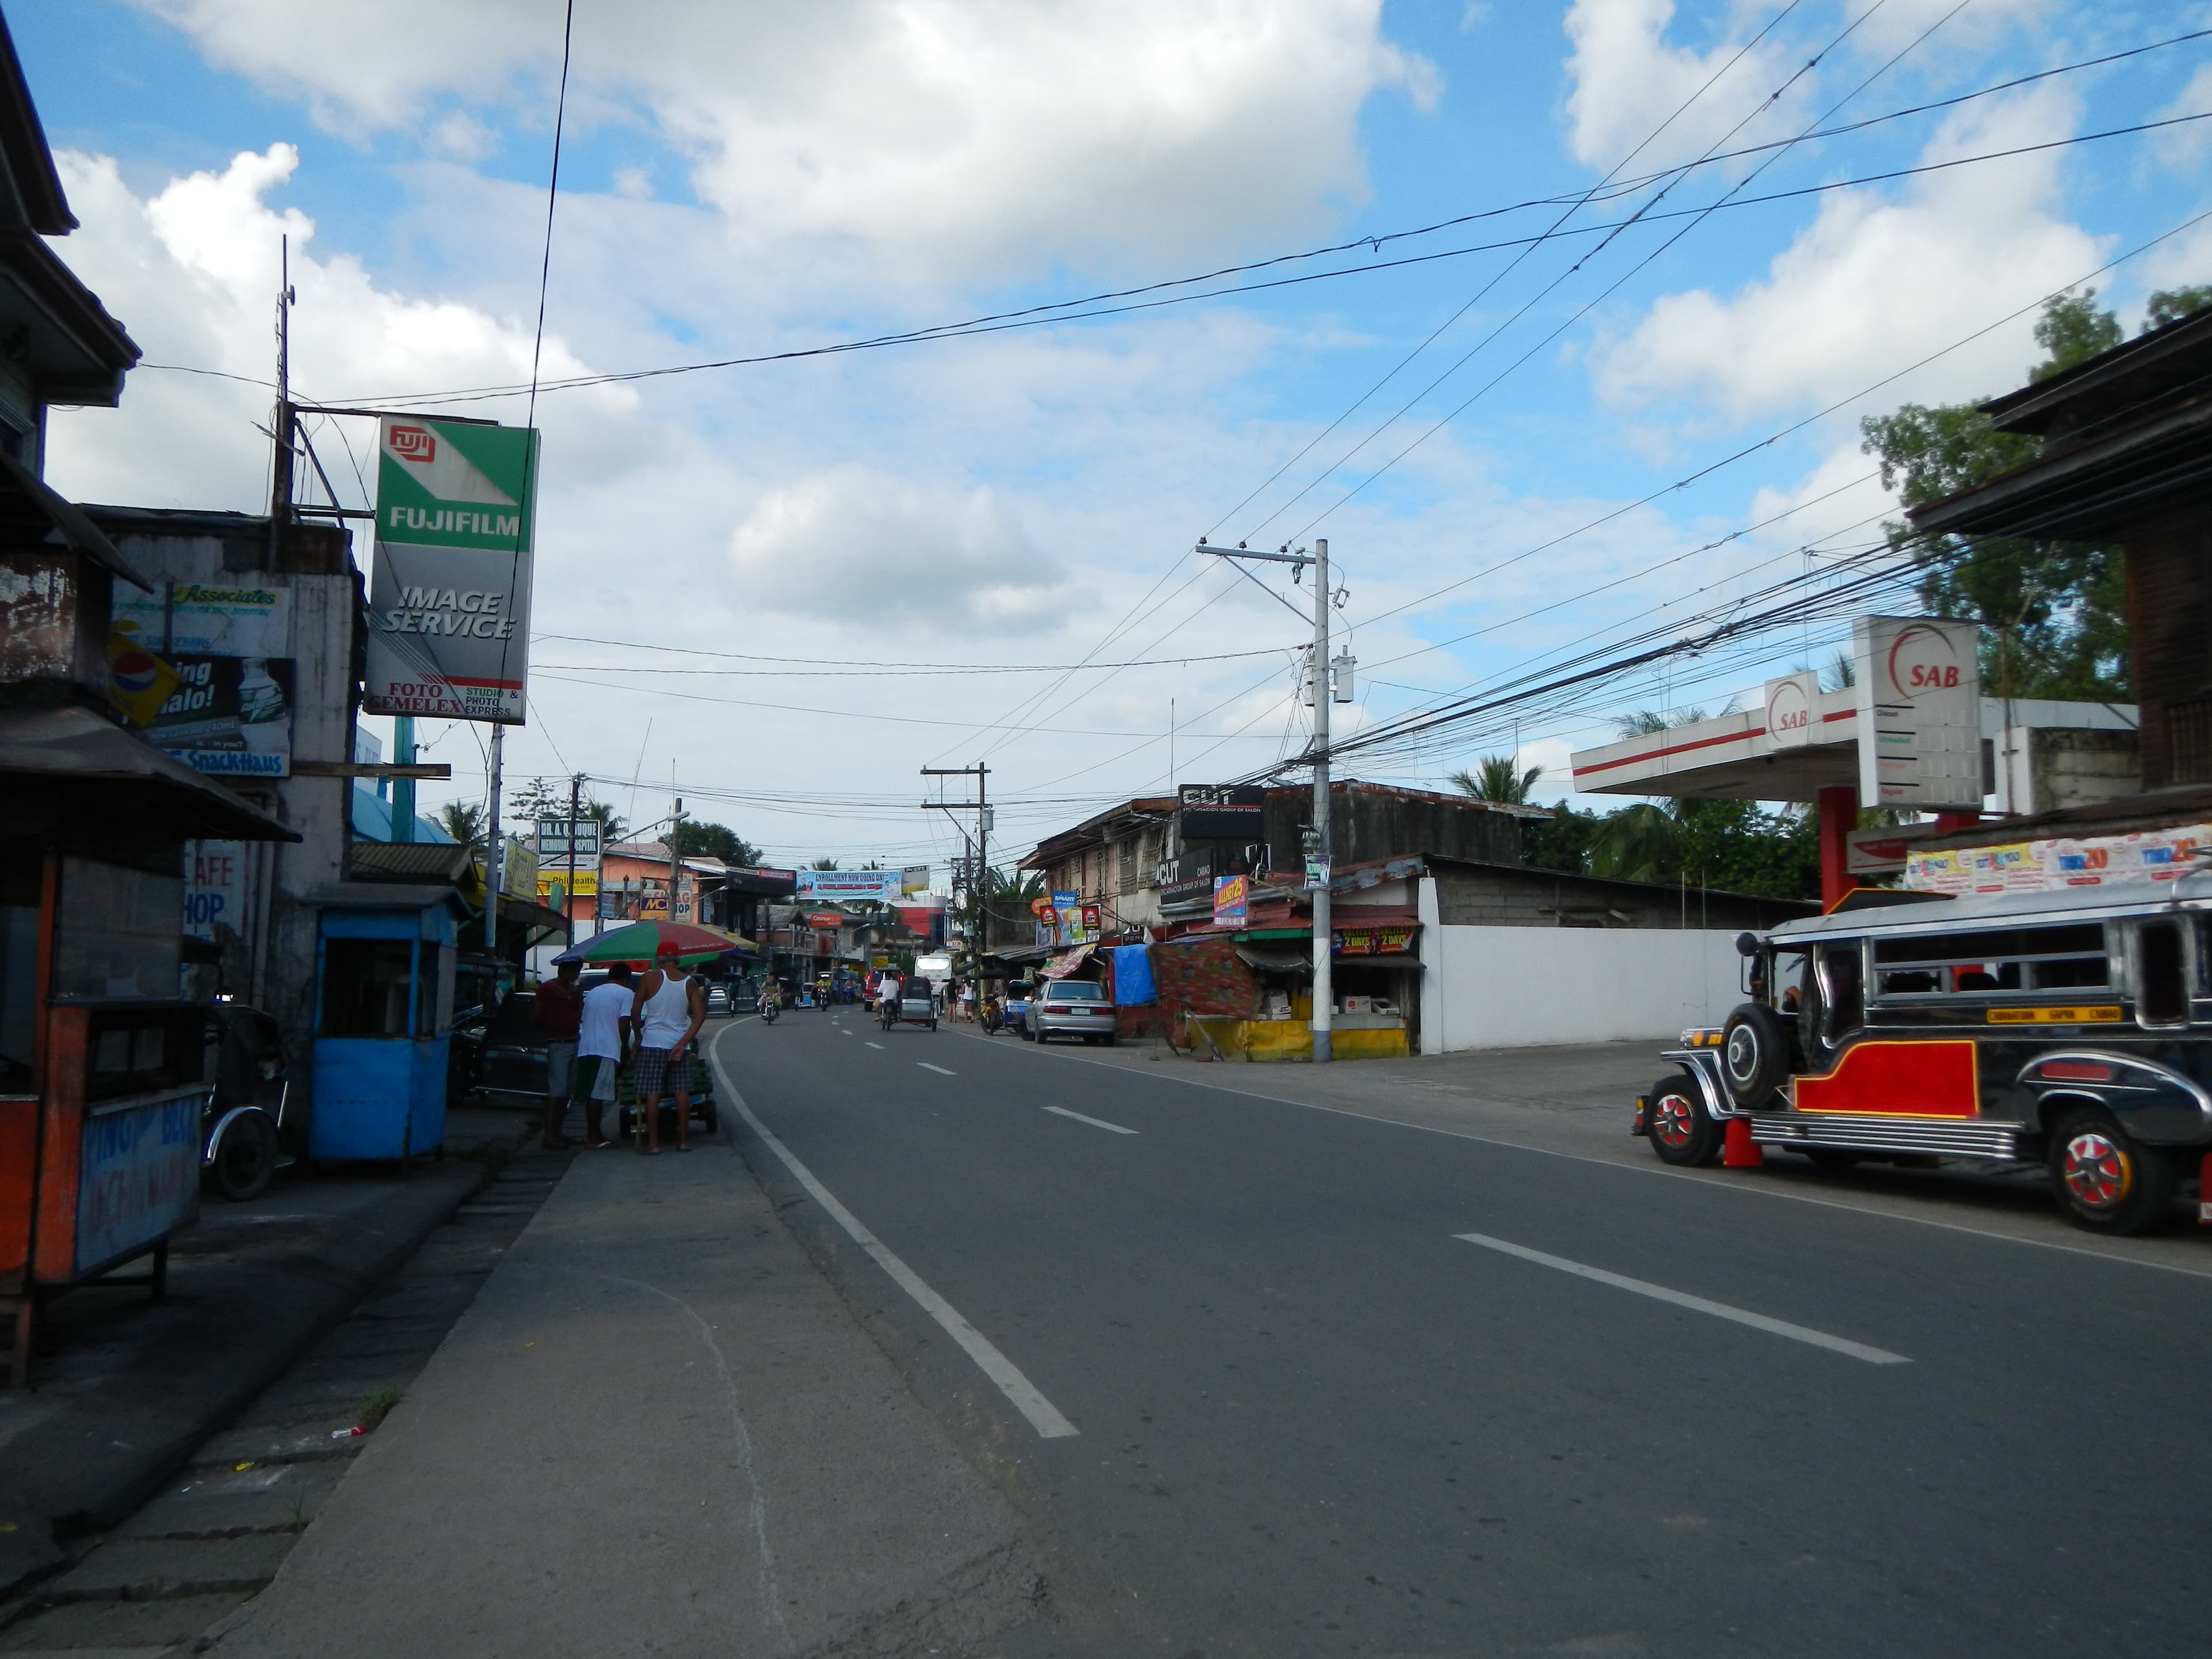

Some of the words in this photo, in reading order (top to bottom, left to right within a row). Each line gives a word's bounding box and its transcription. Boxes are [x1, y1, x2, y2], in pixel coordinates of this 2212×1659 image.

[395, 431, 429, 456] FUJI
[390, 506, 518, 537] FUJIFILM
[175, 584, 275, 605] Associates
[397, 586, 503, 615] IMAGE
[381, 610, 517, 640] SERVICE
[176, 661, 212, 686] ing
[1910, 664, 1959, 688] SAB
[160, 684, 216, 714] alo!
[388, 682, 442, 698] FOTO
[466, 688, 504, 698] STUDIO
[510, 690, 518, 699] &
[369, 695, 462, 714] GEMELEX
[465, 697, 500, 707] PHOTO
[465, 705, 511, 716] EXPRESS
[1780, 710, 1808, 730] SAB
[1183, 789, 1234, 805] CUT
[574, 839, 596, 851] OSPITAL
[184, 856, 233, 887] AFE
[815, 873, 847, 881] ENROLLMENT
[848, 873, 859, 881] NOW
[860, 873, 875, 881] GOING
[1159, 860, 1180, 886] CUT
[184, 893, 224, 925] HOP
[1345, 936, 1350, 946] 2
[1351, 937, 1370, 946] DAYS
[1382, 935, 1387, 945] 2
[1388, 934, 1407, 945] DAYS
